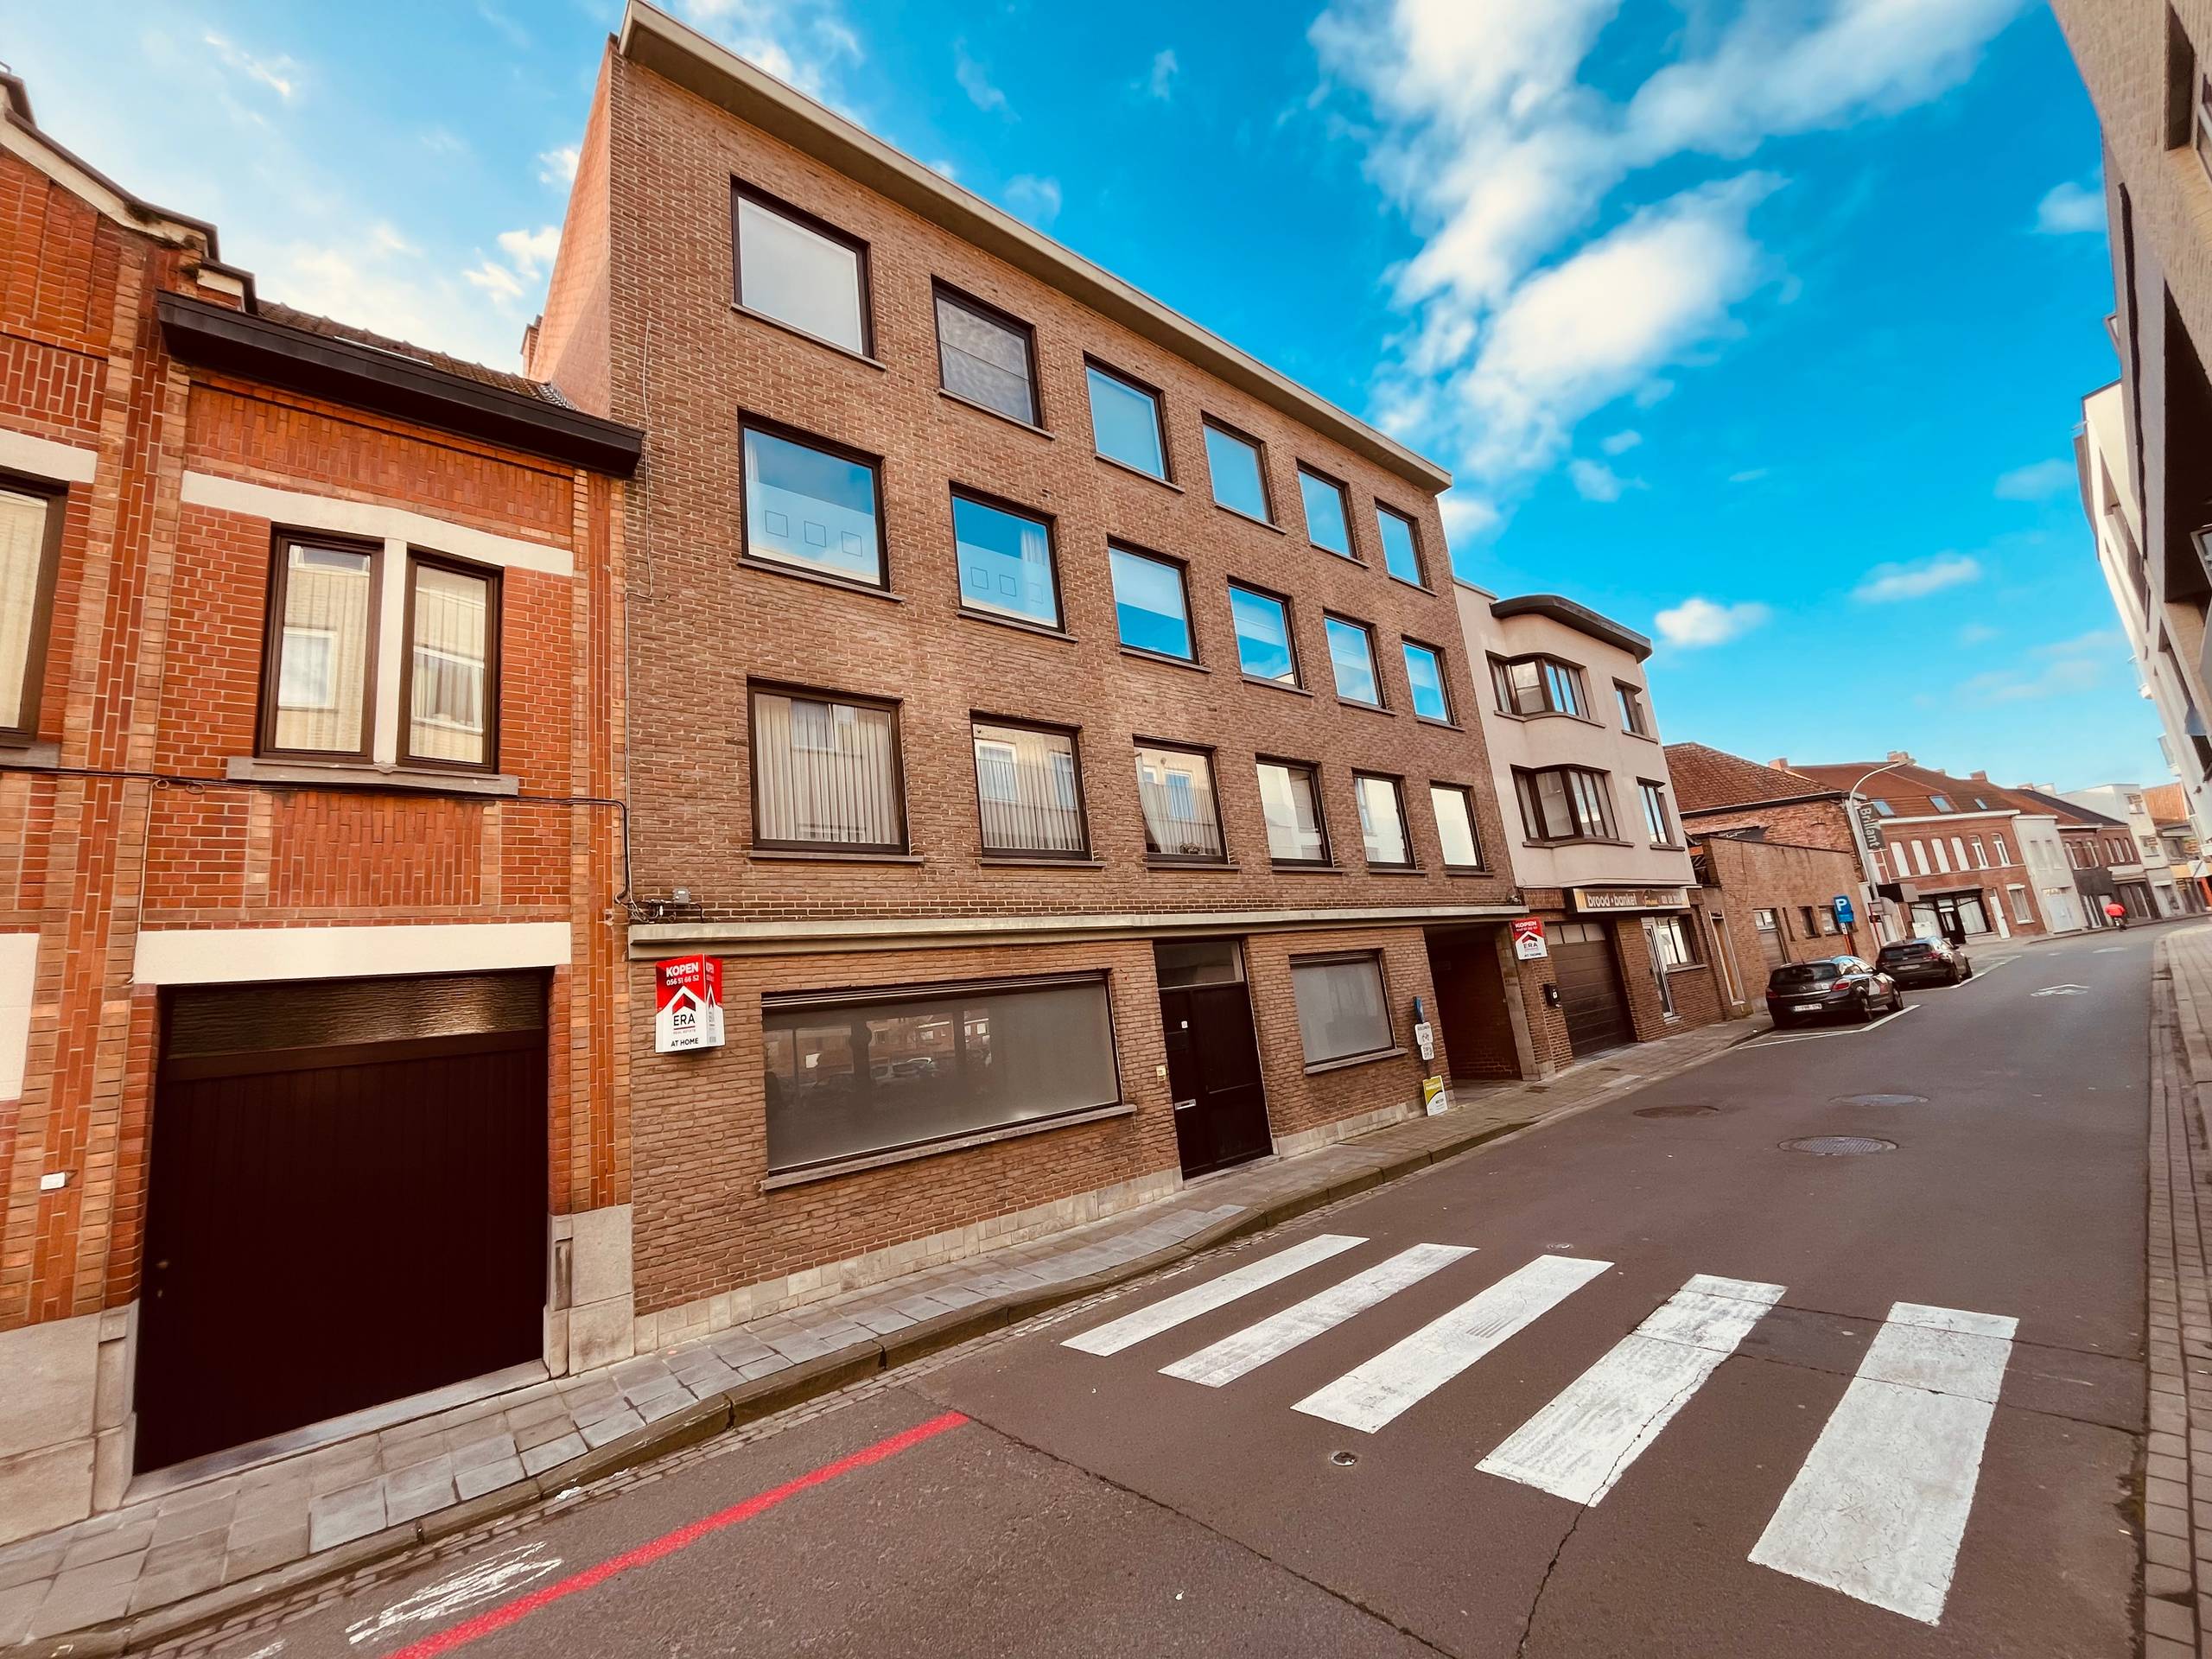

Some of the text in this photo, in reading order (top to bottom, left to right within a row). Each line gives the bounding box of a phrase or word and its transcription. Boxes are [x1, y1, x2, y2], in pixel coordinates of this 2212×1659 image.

[1859, 807, 1881, 848] Brillant
[1586, 893, 1611, 907] brood
[1835, 898, 1847, 912] P
[1515, 920, 1537, 929] KOPEN
[665, 962, 699, 977] KOPEN
[673, 1013, 696, 1027] ERA
[680, 1037, 699, 1046] HOME
